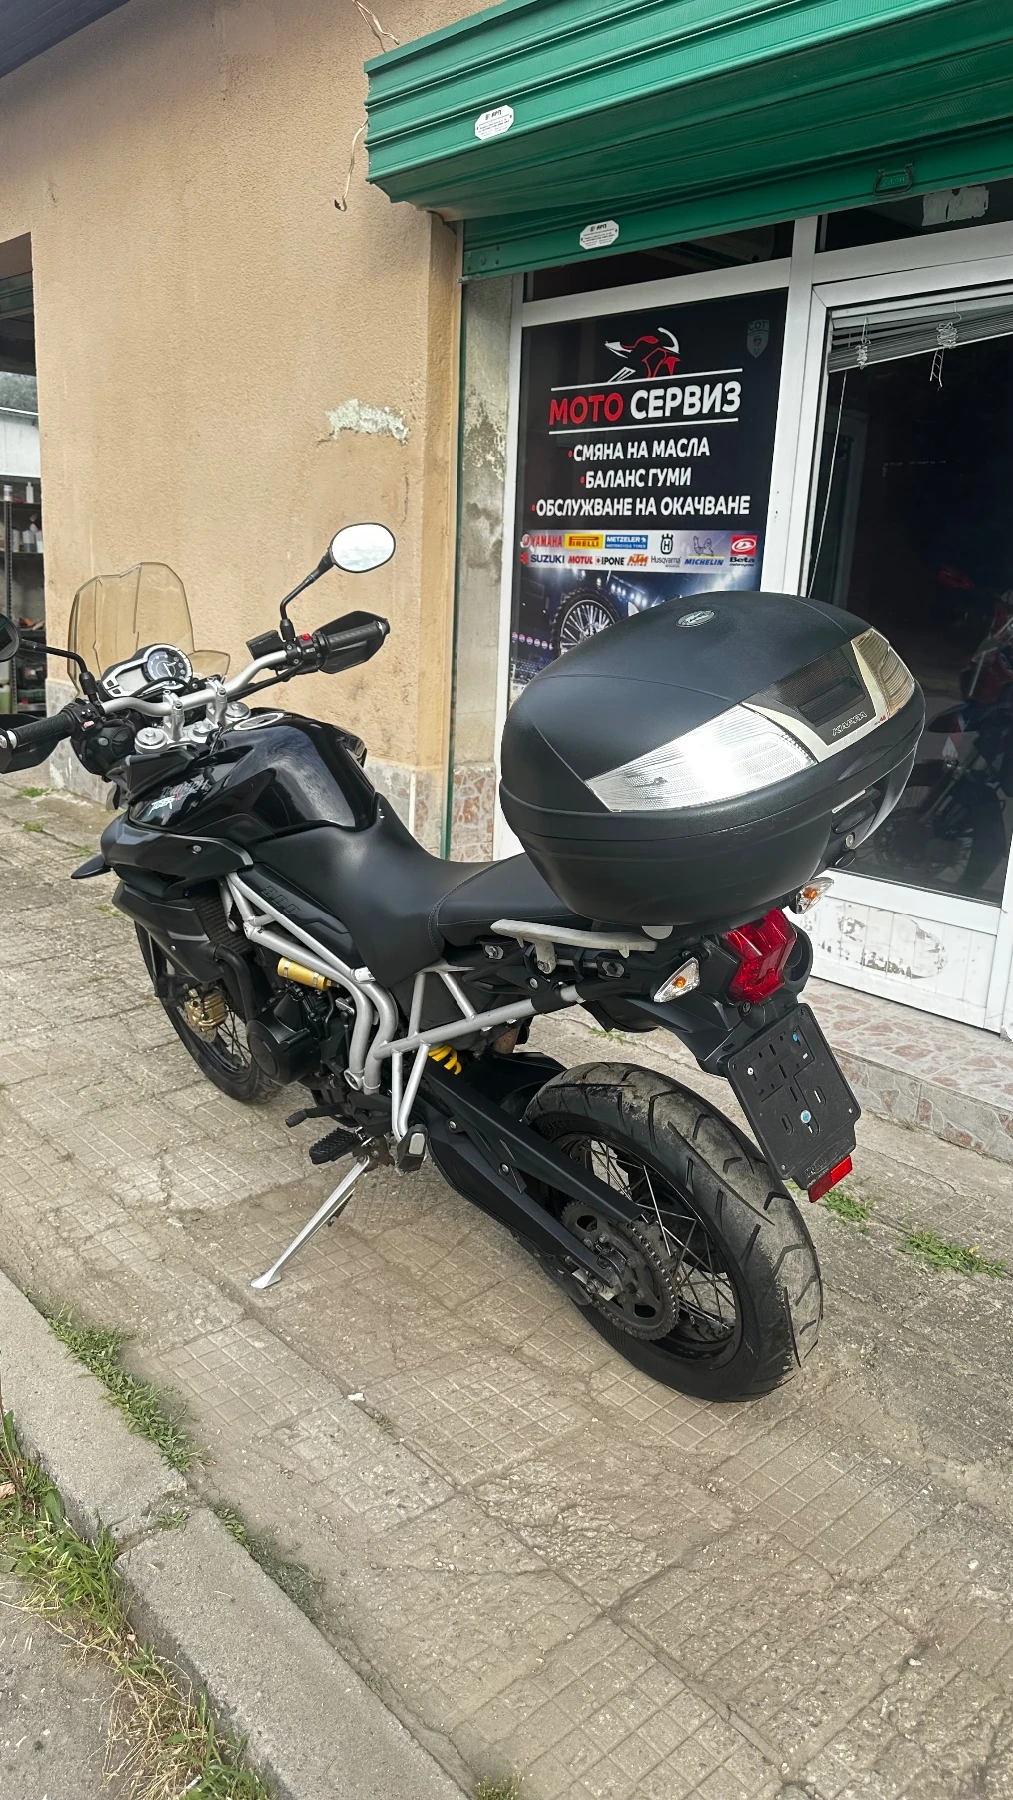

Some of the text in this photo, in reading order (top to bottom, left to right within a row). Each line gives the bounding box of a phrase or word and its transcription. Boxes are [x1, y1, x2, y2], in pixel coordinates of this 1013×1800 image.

[549, 381, 742, 426] МОТО СЕРВИЗ
[573, 437, 710, 462] СМЯНА НА МАСЛА
[585, 467, 692, 489] БАЛАНС ГУМИ
[536, 495, 751, 517] ОБСЛУЖВАНЕ НА ОКАЧВАНЕ
[531, 535, 563, 548] YAMAHA
[568, 536, 600, 547] PIRELLI
[530, 554, 565, 563] SUZUKI
[568, 555, 593, 565] MOTUL
[601, 556, 625, 566] IPONE
[628, 554, 649, 564] KTM
[650, 555, 681, 565] Husqvarna
[684, 558, 724, 566] MICHELIN
